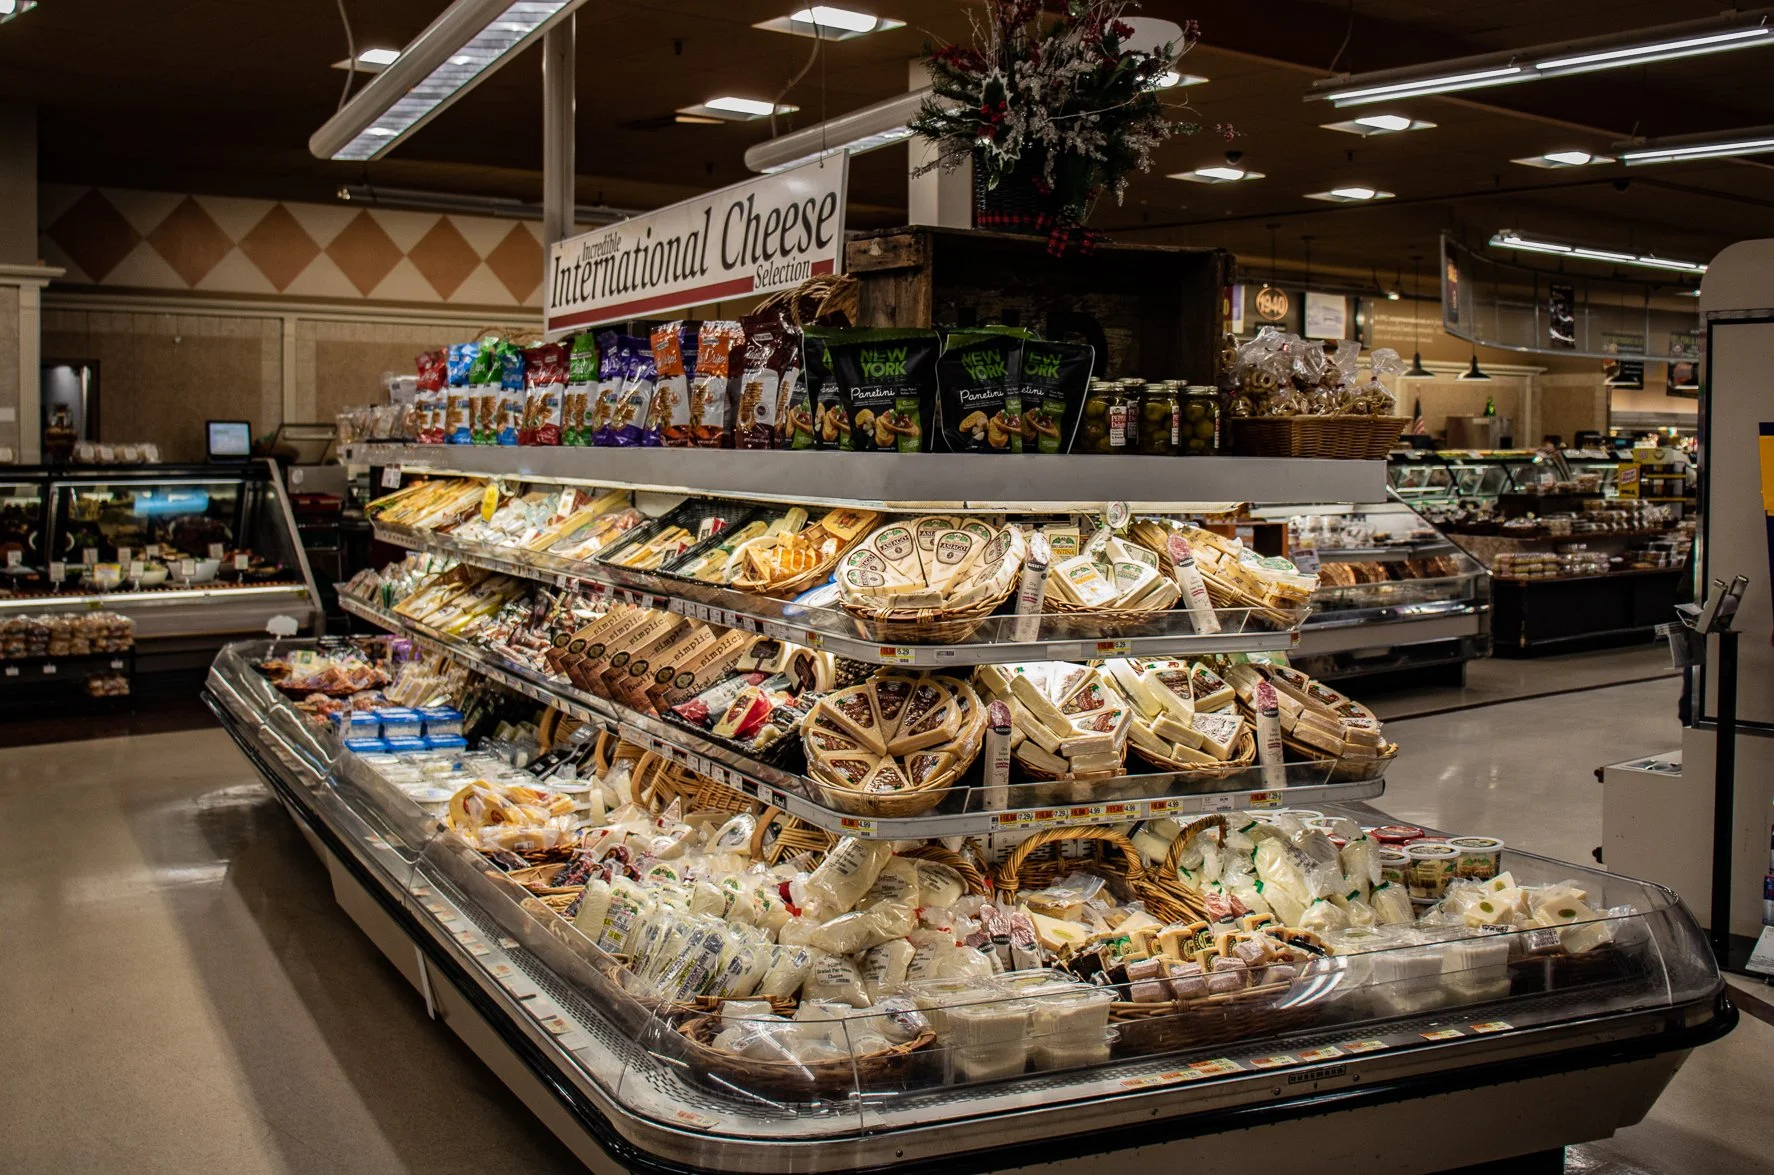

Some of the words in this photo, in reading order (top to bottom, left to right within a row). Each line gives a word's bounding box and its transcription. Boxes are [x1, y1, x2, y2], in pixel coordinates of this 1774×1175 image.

[551, 206, 713, 309] International
[721, 191, 837, 271] Cheese
[582, 231, 622, 262] Incredible
[755, 256, 811, 289] Selection
[1260, 295, 1284, 314] 1940
[860, 346, 908, 363] NEW
[962, 348, 1001, 366] NEW
[1028, 352, 1063, 365] EW
[860, 361, 908, 378] YORK
[966, 360, 1008, 381] YORK
[1023, 362, 1060, 379] ORK
[850, 386, 896, 400] Panetini
[959, 388, 1004, 403] Panetini
[880, 535, 910, 551] ASIAGO
[940, 542, 968, 552] ASIAGO
